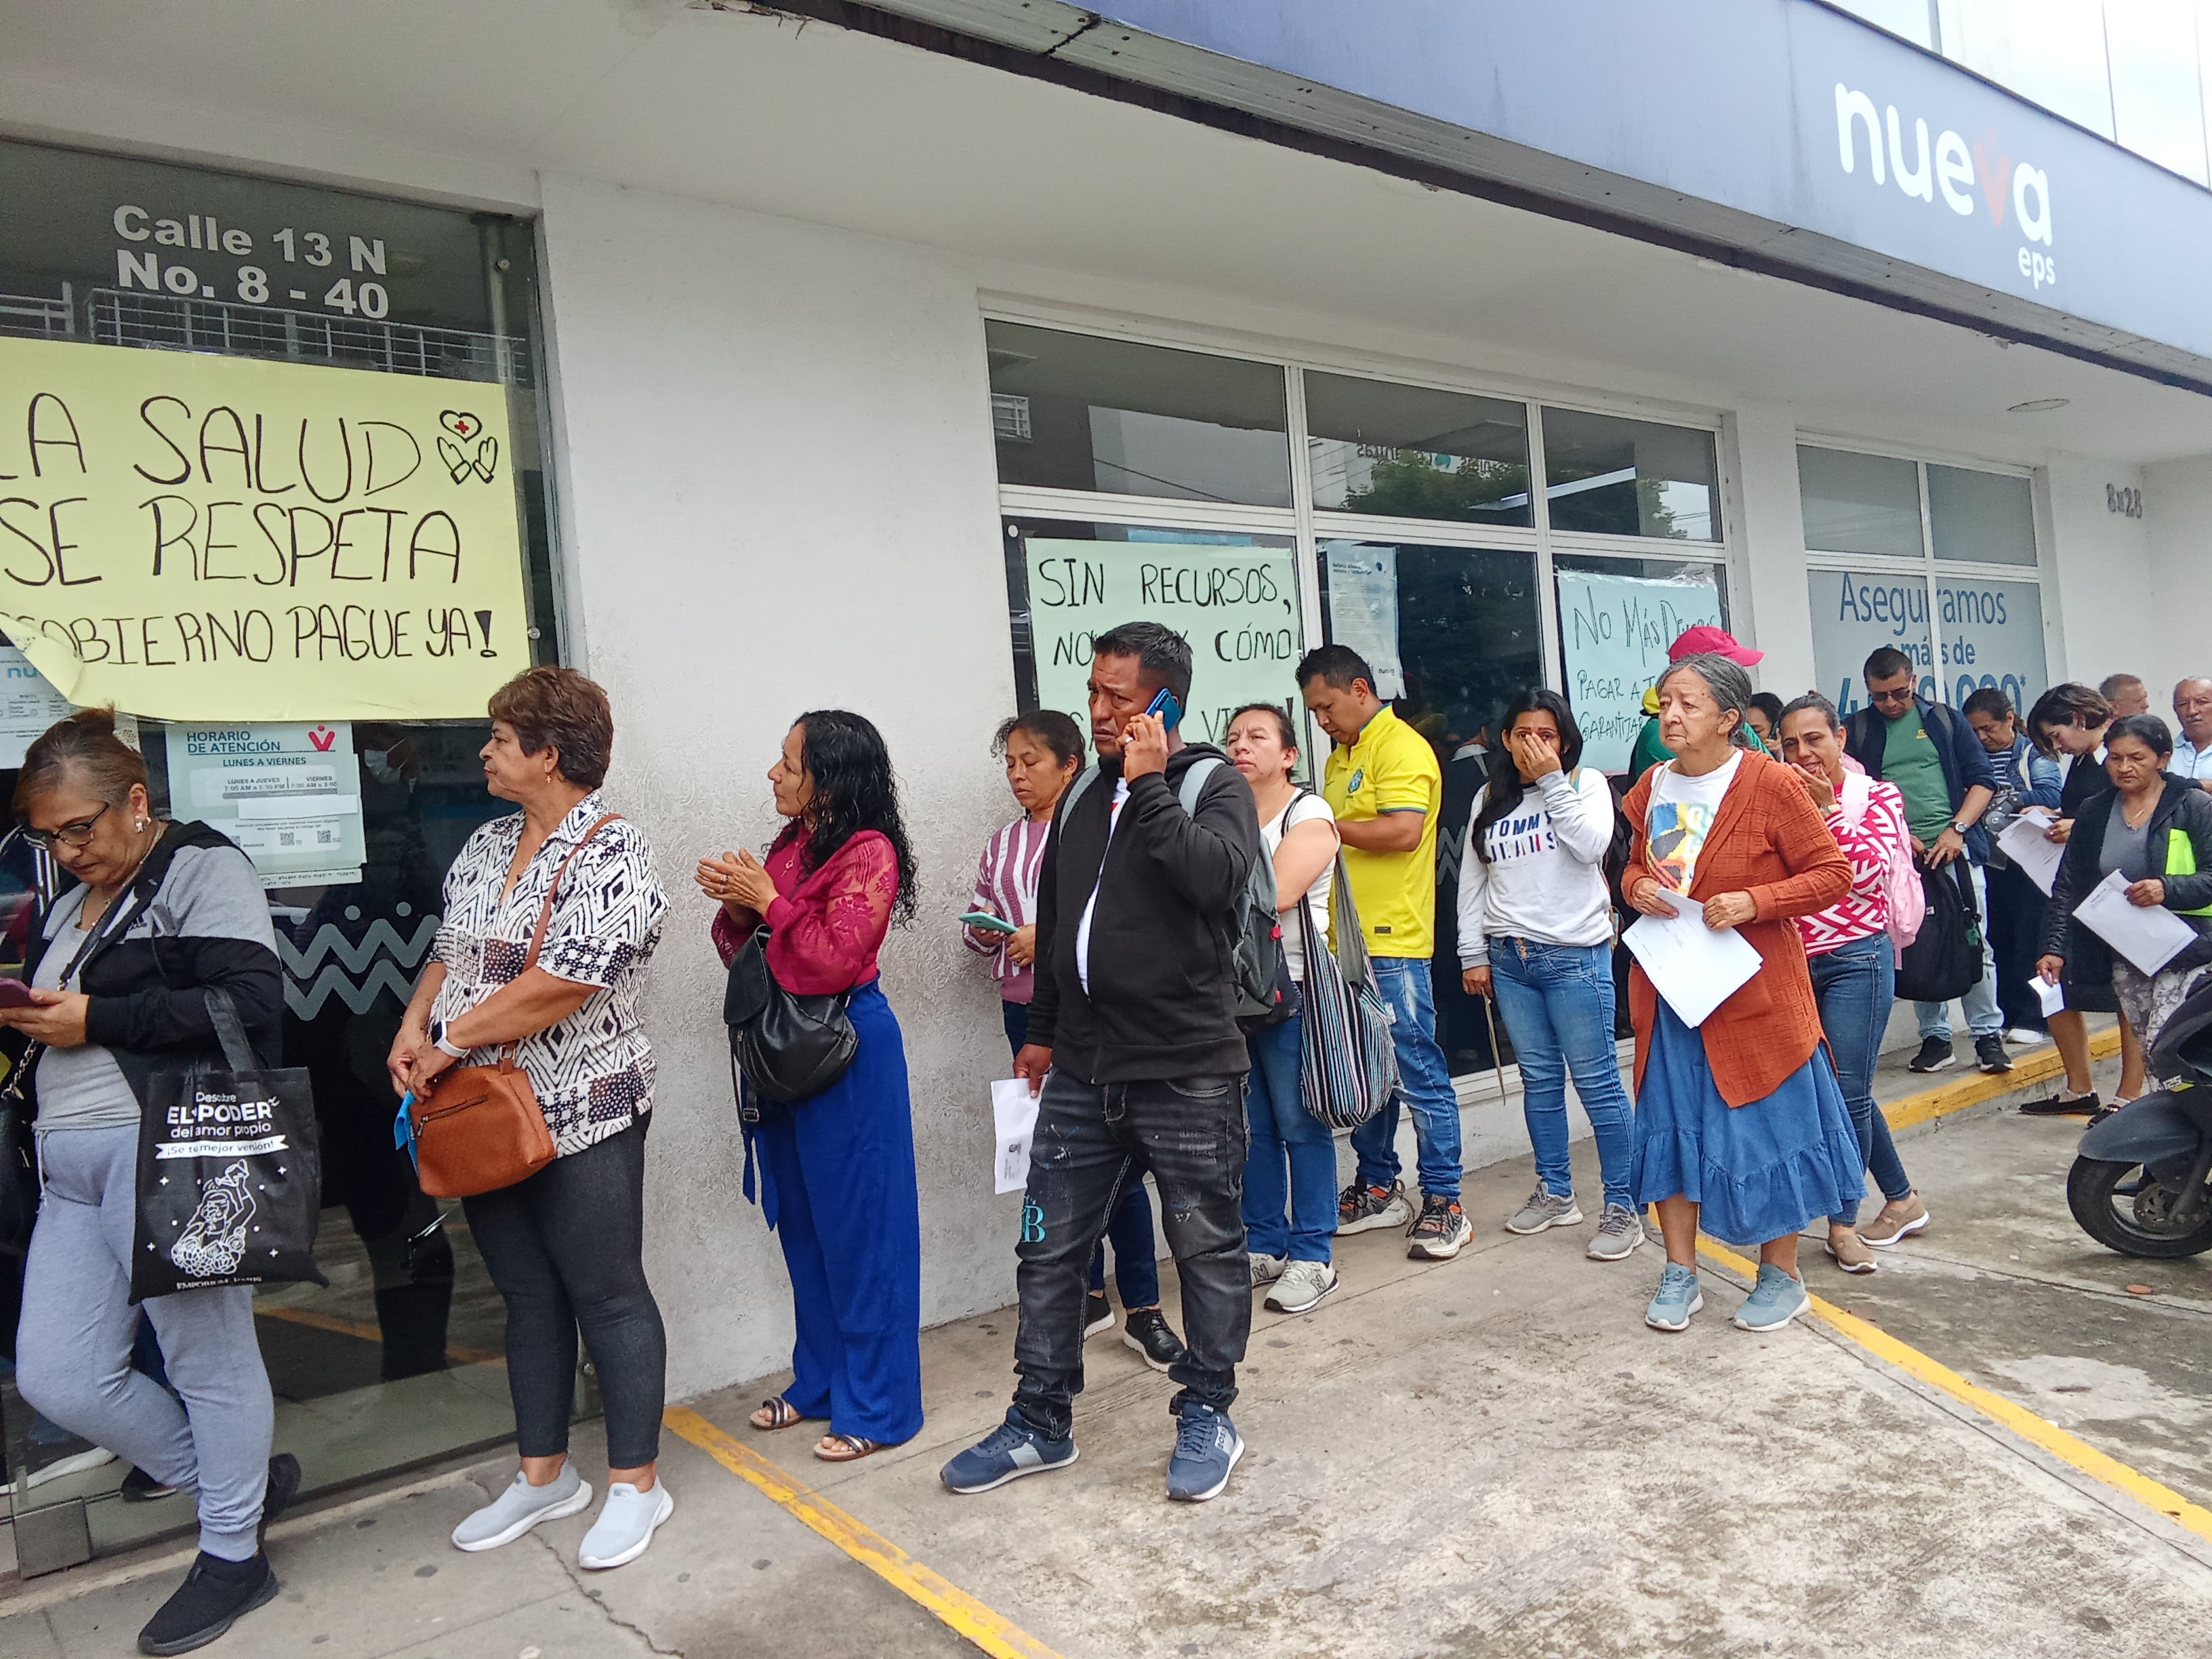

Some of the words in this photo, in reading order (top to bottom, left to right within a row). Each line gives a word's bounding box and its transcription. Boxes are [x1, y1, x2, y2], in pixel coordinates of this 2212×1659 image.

[1835, 82, 2053, 246] nueva
[112, 205, 253, 256] Calle
[272, 227, 333, 267] 13
[349, 237, 387, 275] N
[116, 249, 215, 299] No.
[237, 266, 270, 304] 8
[324, 279, 388, 319] 40
[2018, 246, 2056, 289] eps
[0, 392, 86, 480] A
[134, 395, 422, 504] SALUD
[0, 497, 102, 586] SE
[138, 495, 461, 587] RESPETA
[1038, 558, 1104, 608] SIN
[1141, 562, 1292, 614] RECURSOS,
[1839, 571, 2007, 636] Aseguramos
[286, 604, 412, 661] PAGUE
[425, 607, 497, 657] YA!
[1214, 621, 1292, 662] CÓMO
[1574, 585, 1612, 651] NO
[1622, 596, 1660, 668] MÁS
[1952, 635, 1976, 665] de
[1577, 669, 1624, 701] PAGAR
[1631, 681, 1640, 701] A
[186, 731, 251, 742] HORARIO
[187, 743, 204, 754] DE
[209, 739, 281, 753] ATENCIÓN
[222, 758, 255, 767] LUNES
[266, 756, 307, 766] VIERNES
[2163, 1074, 2182, 1090] 125
[167, 1105, 194, 1124] EL
[197, 1101, 273, 1123] PODER
[170, 1125, 193, 1139] del
[194, 1126, 231, 1136] amor
[233, 1120, 272, 1138] propio
[199, 1142, 234, 1153] mejor
